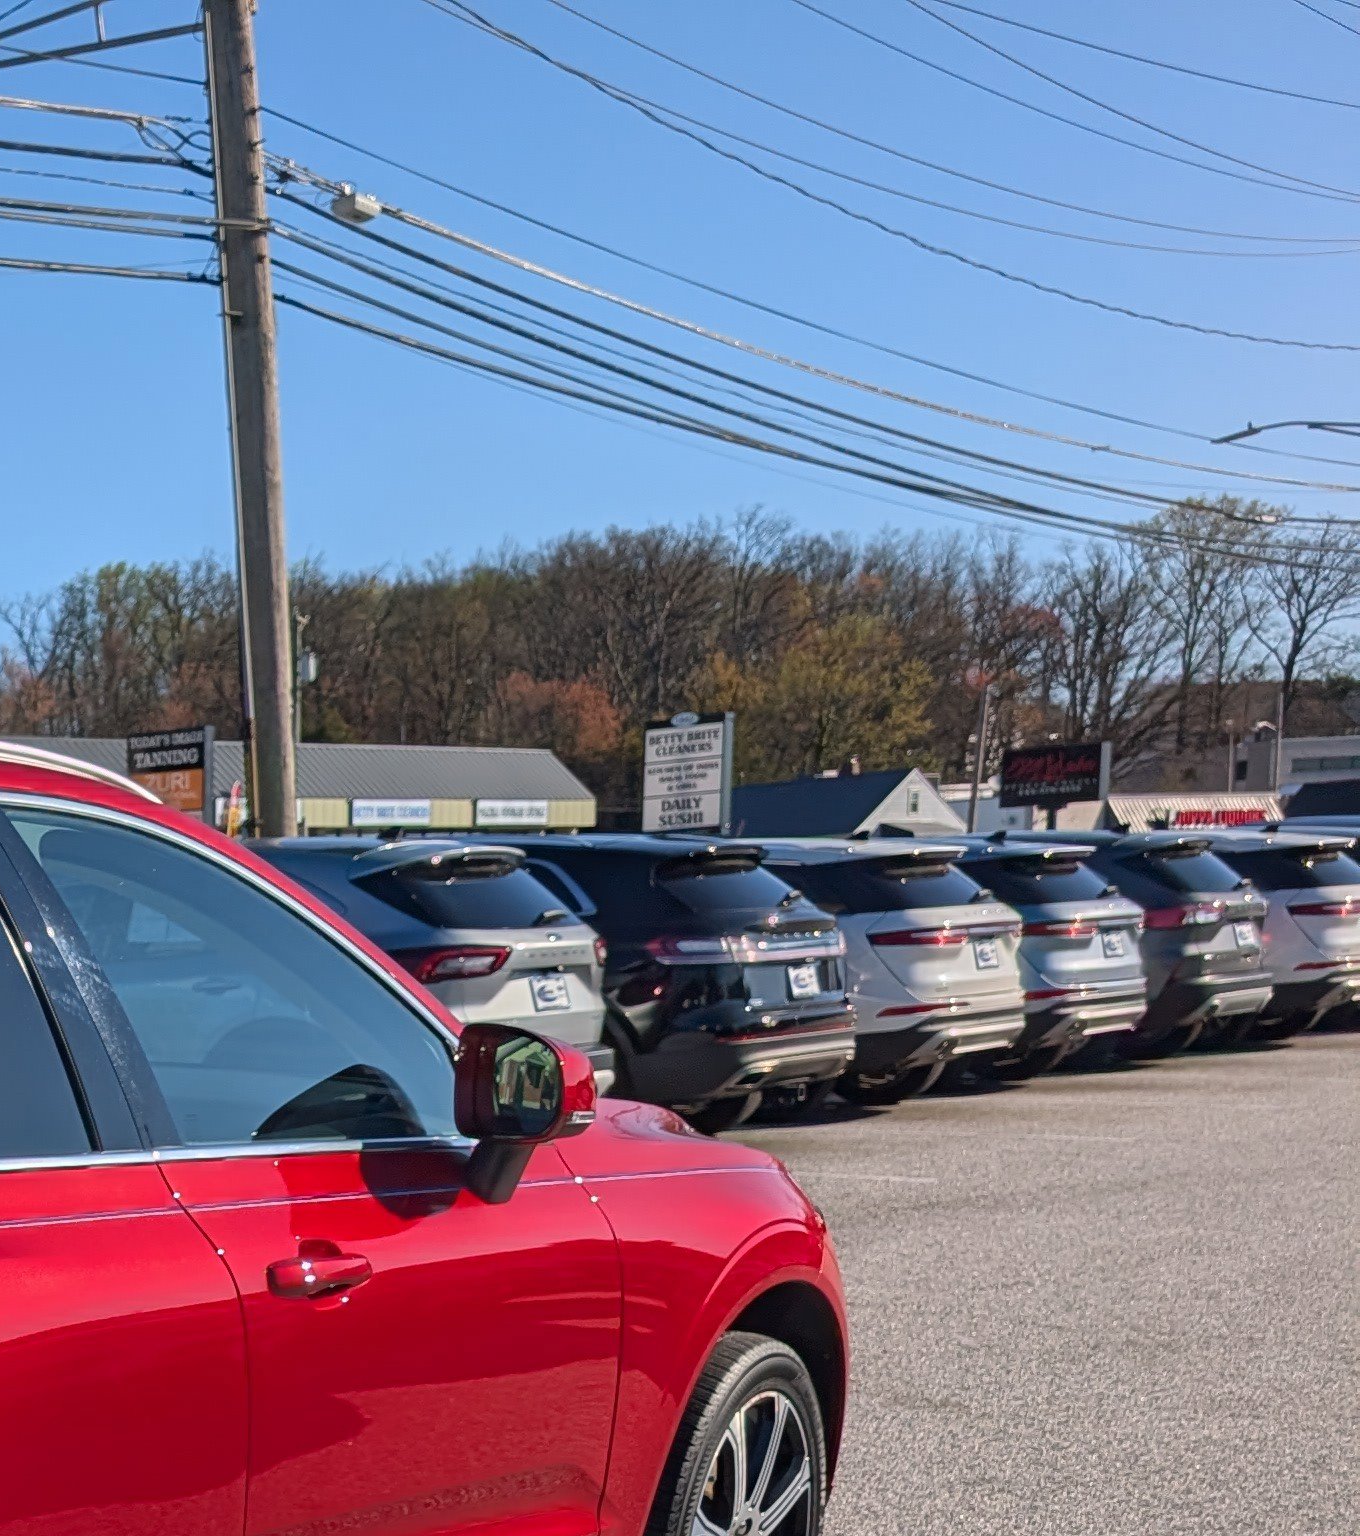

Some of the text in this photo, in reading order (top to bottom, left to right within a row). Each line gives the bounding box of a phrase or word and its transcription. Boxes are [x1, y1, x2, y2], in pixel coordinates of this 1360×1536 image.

[649, 727, 720, 746] BETTY BRITE
[655, 742, 713, 757] CLEANERS
[133, 747, 199, 768] TANNING
[661, 797, 702, 812] DAILY
[658, 811, 703, 826] SUSHI
